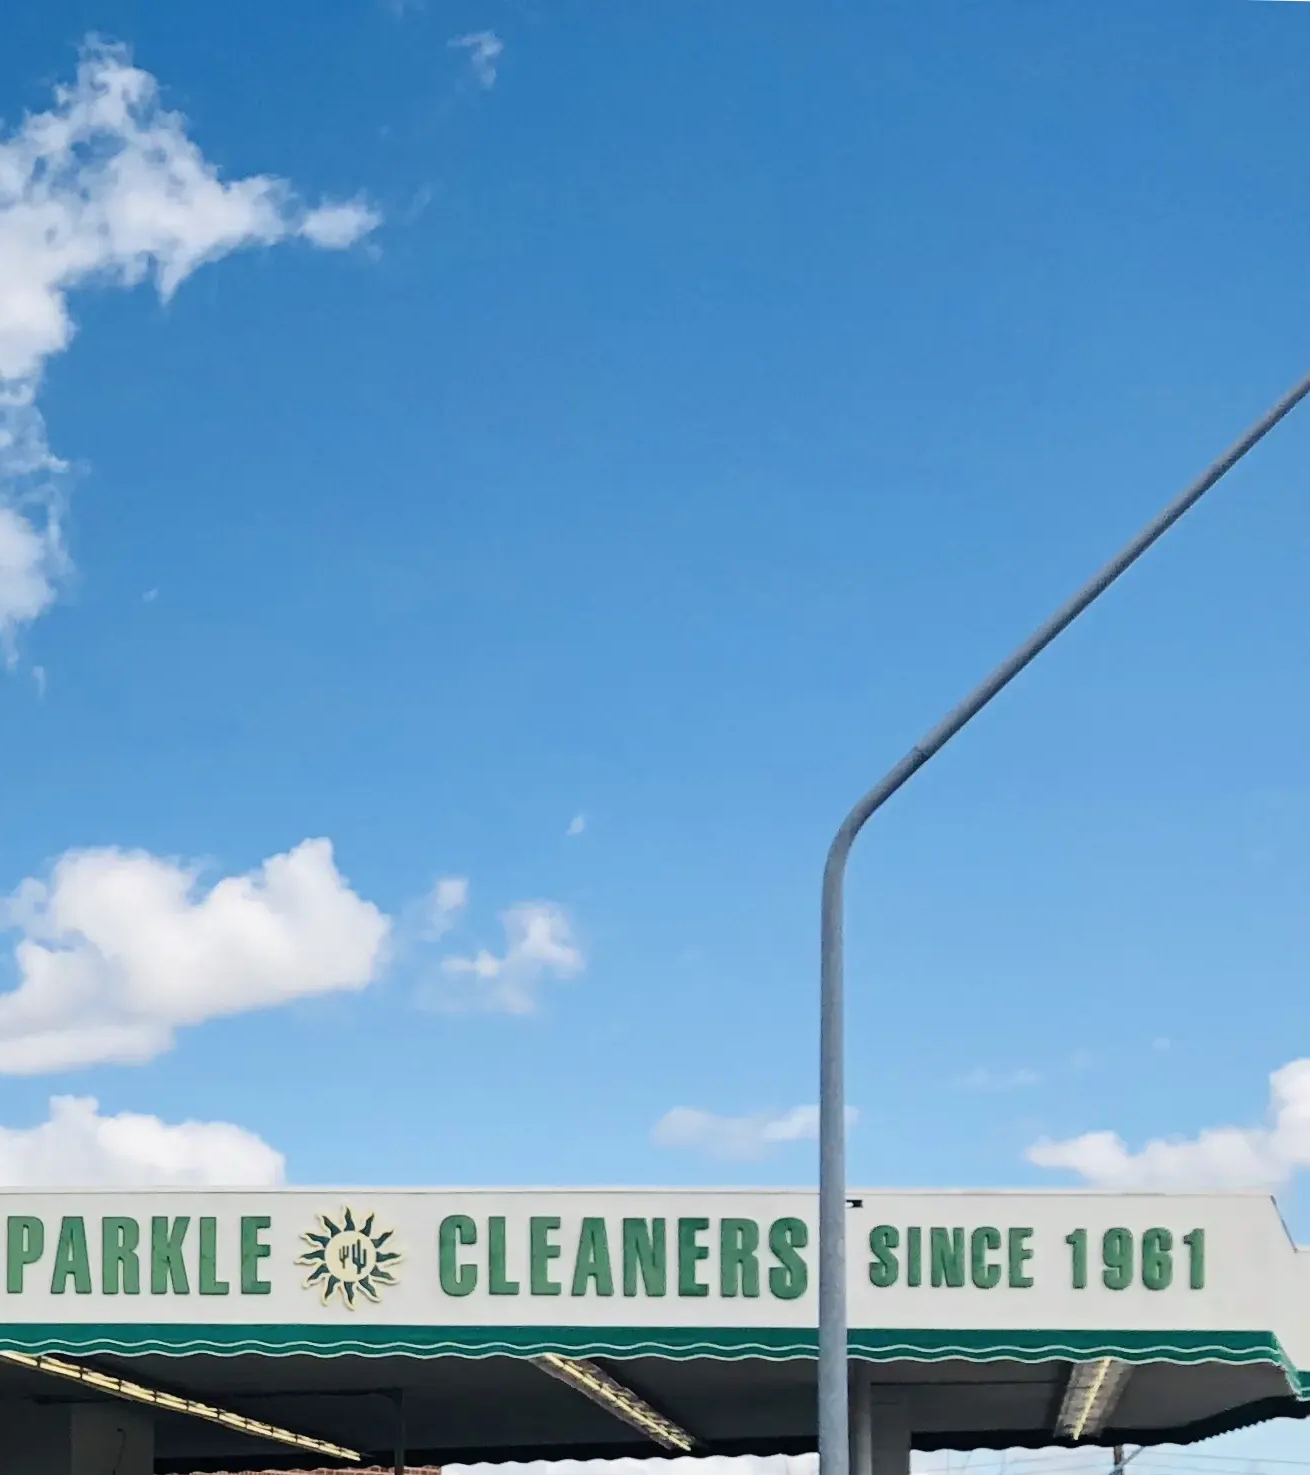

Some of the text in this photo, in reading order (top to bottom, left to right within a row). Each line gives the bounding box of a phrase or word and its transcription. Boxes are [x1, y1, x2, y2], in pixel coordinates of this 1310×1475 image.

[438, 1213, 809, 1301] CLEANERS
[868, 1224, 1035, 1290] SINCE
[1065, 1226, 1206, 1291] 1961
